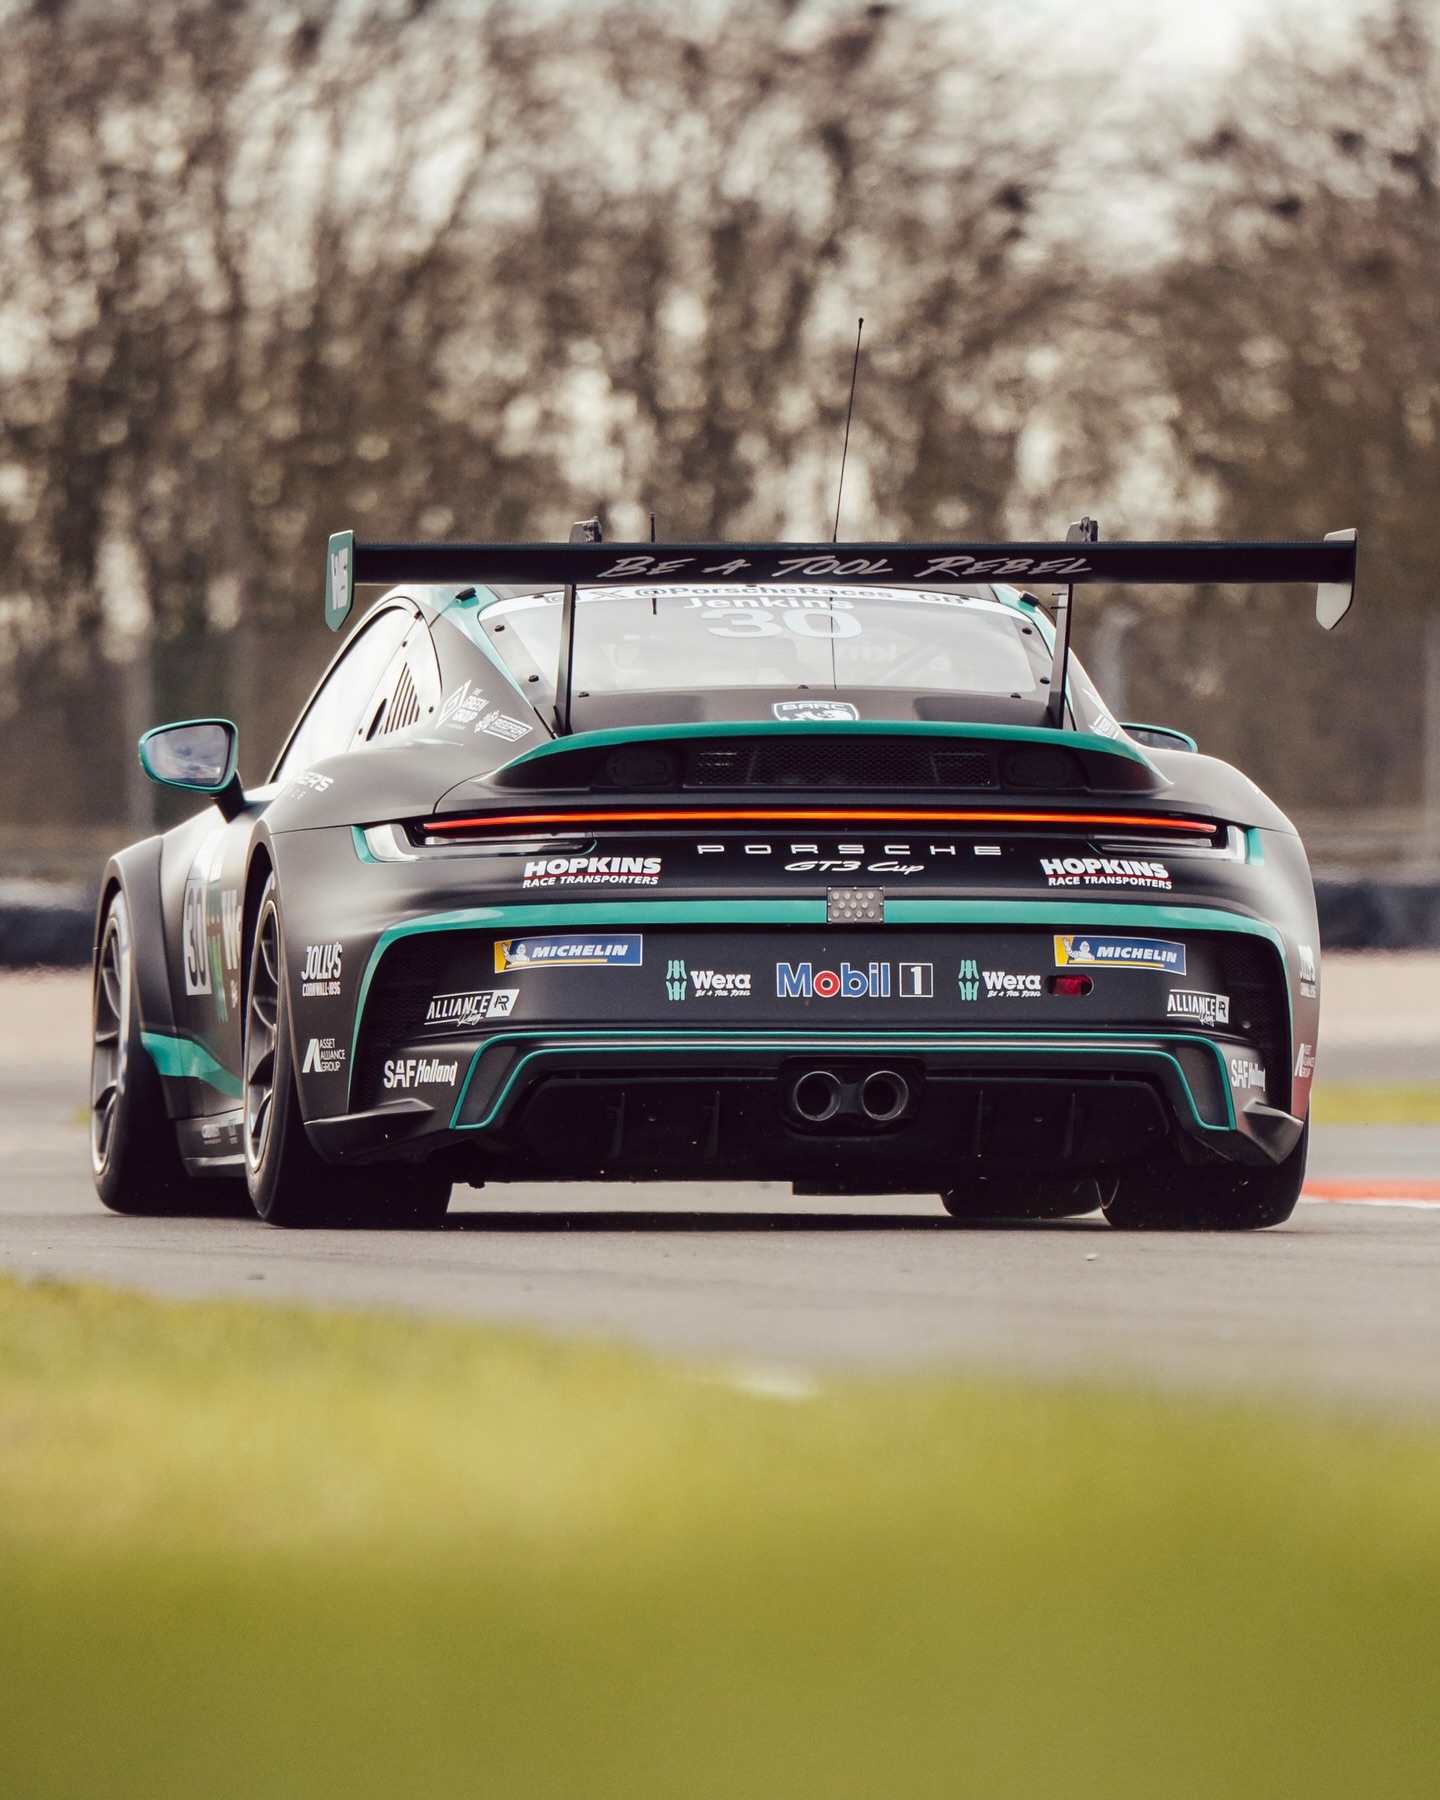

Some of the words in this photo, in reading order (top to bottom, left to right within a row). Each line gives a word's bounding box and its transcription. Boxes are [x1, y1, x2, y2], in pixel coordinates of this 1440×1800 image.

[597, 556, 697, 578] BE
[702, 558, 752, 576] A
[771, 555, 894, 578] TOOL
[913, 555, 1093, 578] REBEL
[684, 596, 855, 610] Jenkins
[701, 608, 863, 639] 30
[782, 702, 850, 712] BARC
[697, 844, 1002, 856] PORSCHE
[523, 856, 662, 878] HOPKINS
[784, 861, 861, 872] GT3
[867, 861, 925, 875] Cup
[1039, 857, 1169, 879] HOPKINS
[522, 876, 556, 889] RACE
[560, 875, 659, 885] TRANSPORTERS
[1049, 876, 1080, 887] RACE
[1084, 876, 1173, 890] TRANSPORTERS
[301, 941, 343, 980] JOLLY'S
[531, 944, 629, 959] MICHELIN
[1096, 946, 1178, 963] MICHELIN
[690, 970, 751, 990] Wera
[776, 962, 891, 998] Mobil
[910, 966, 923, 996] 1
[982, 971, 1042, 990] Wera
[426, 995, 492, 1021] ALLIANCE
[1167, 994, 1216, 1016] ALLIANCE
[319, 1038, 336, 1050] ASSET
[320, 1050, 346, 1061] ALLIANCE
[319, 1061, 341, 1073] GROUP
[383, 1059, 417, 1089] SAF
[414, 1058, 459, 1089] Holland
